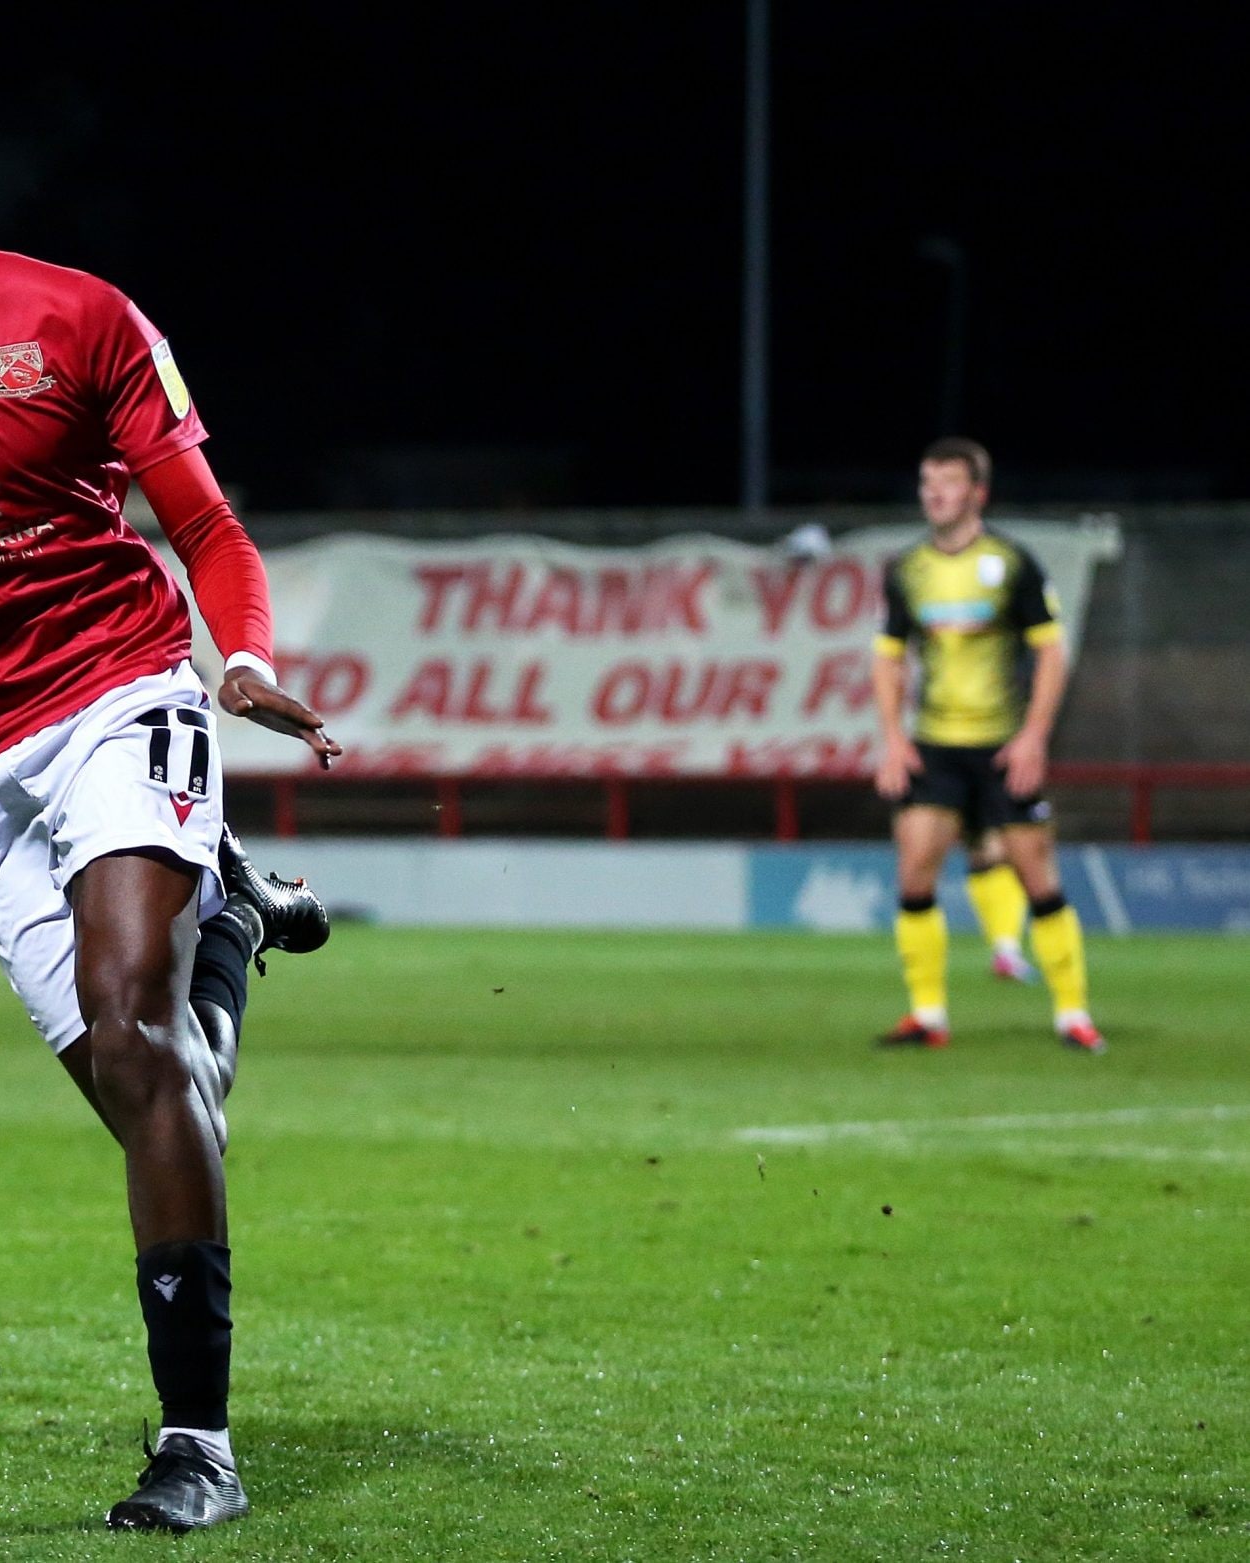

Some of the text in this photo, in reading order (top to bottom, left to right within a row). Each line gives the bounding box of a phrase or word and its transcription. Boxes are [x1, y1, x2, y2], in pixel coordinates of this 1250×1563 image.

[413, 556, 720, 638] THANK
[388, 656, 553, 725] ALL
[589, 657, 782, 728] OUR
[134, 707, 209, 796] 11
